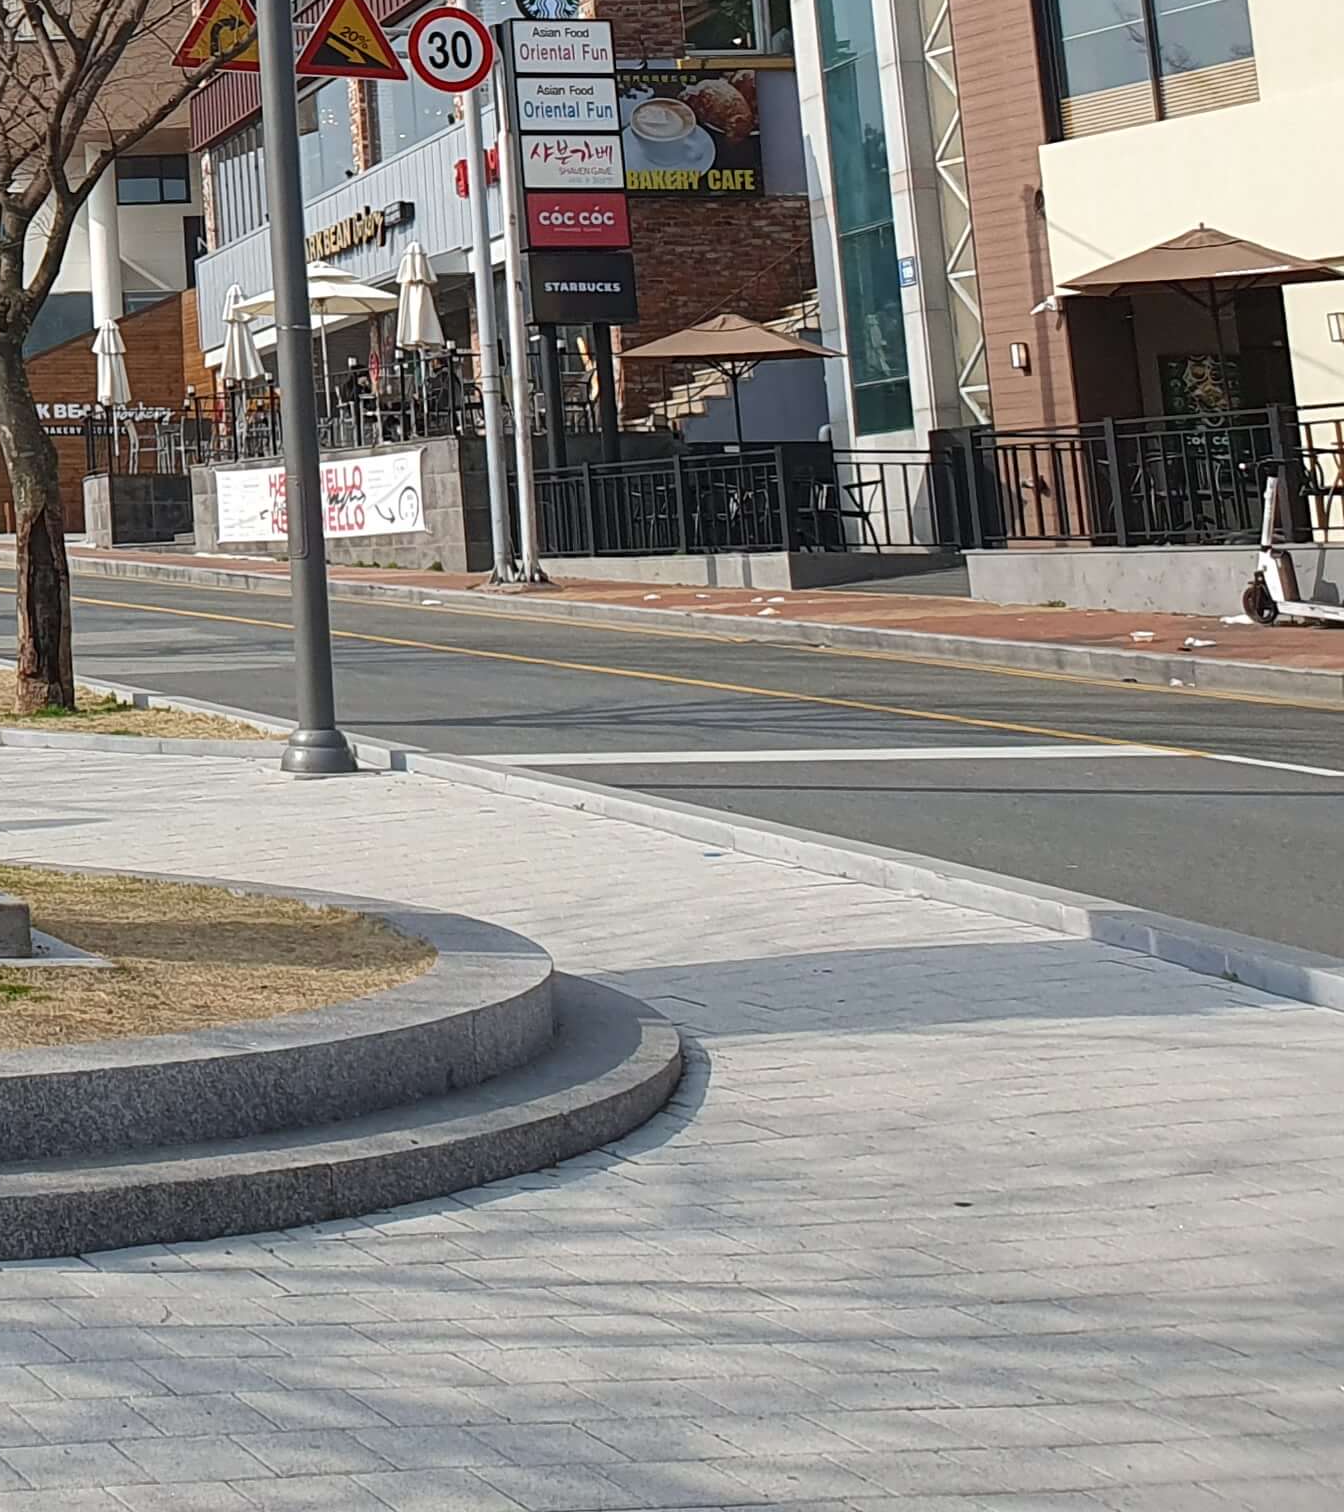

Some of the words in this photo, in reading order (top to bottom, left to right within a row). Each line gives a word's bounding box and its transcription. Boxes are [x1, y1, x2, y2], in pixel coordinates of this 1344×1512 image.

[340, 26, 368, 50] 20%
[532, 27, 561, 38] Asian
[564, 27, 590, 38] Food
[428, 30, 473, 69] 30
[519, 43, 576, 61] Oriental
[582, 44, 609, 61] Fun
[536, 85, 566, 96] Asian
[569, 85, 594, 96] Food
[523, 100, 580, 118] Oriental
[586, 101, 613, 118] Fun
[625, 169, 701, 190] BAKERY
[707, 169, 755, 190] CAFE
[544, 281, 622, 293] STARBUCKS
